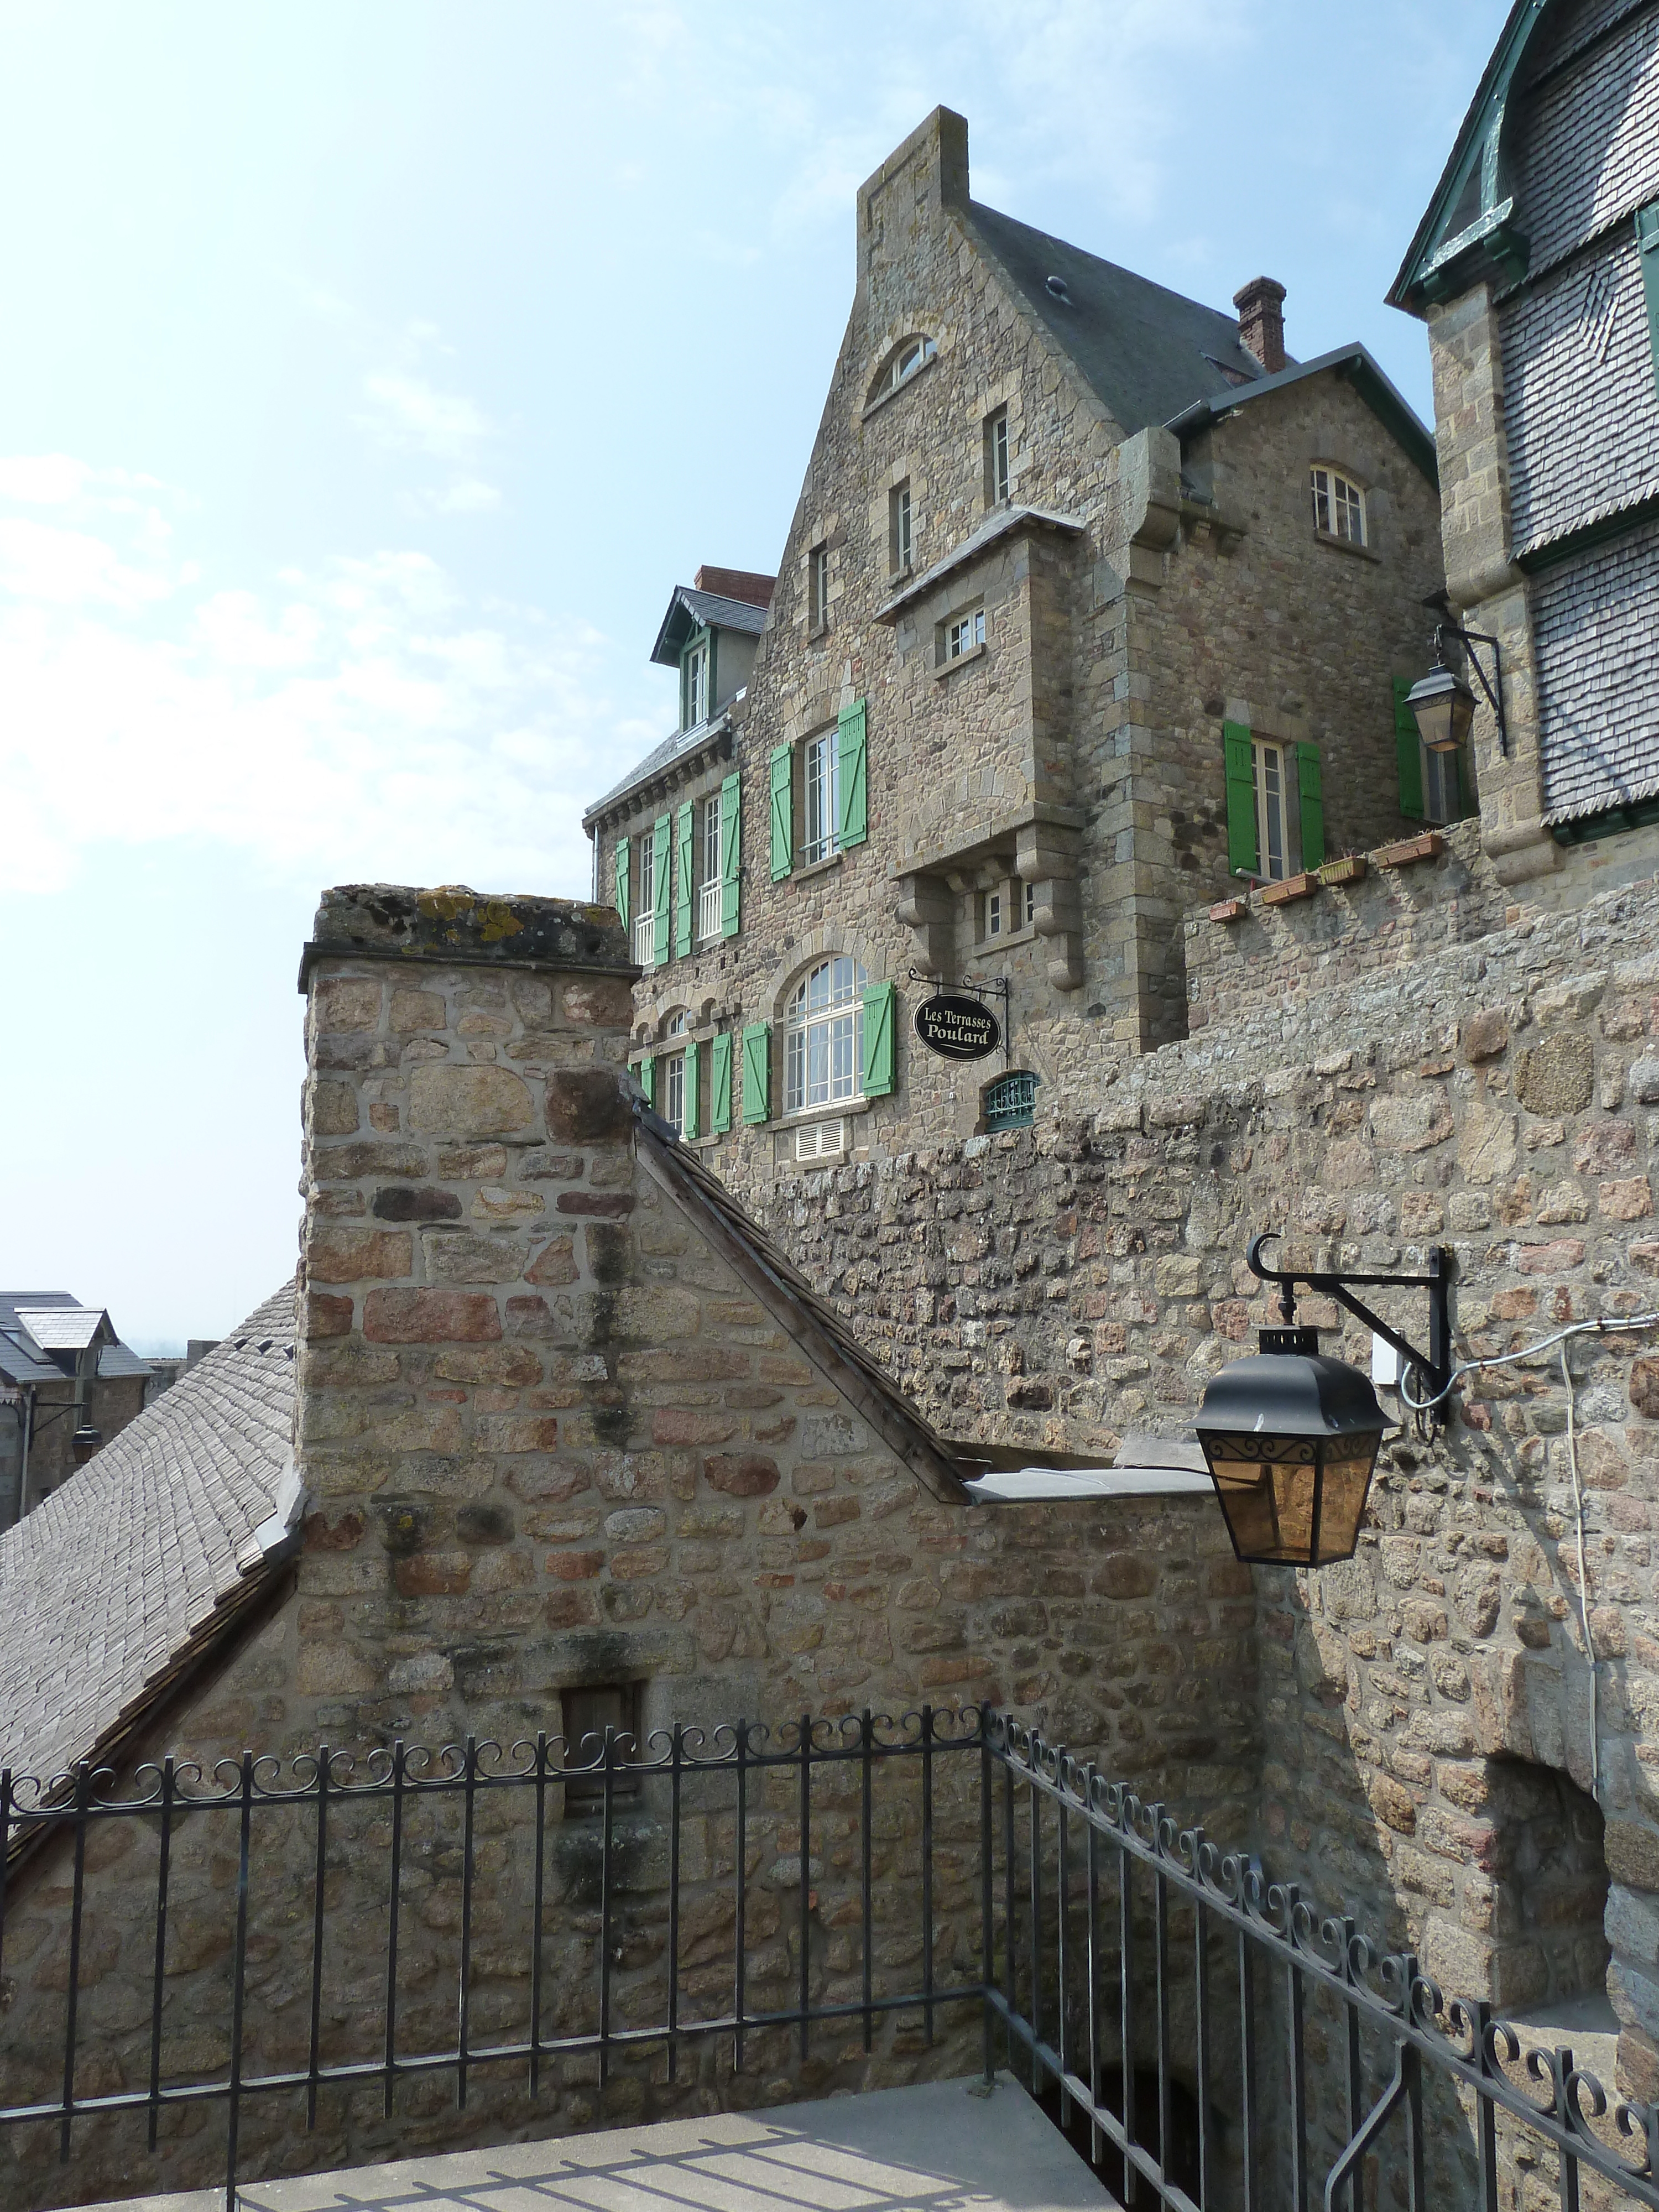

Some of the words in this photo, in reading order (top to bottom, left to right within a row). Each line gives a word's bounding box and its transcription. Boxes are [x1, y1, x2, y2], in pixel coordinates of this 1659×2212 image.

[925, 1008, 942, 1022] Les
[945, 1010, 991, 1030] Terrasses
[927, 1024, 989, 1045] Poulard
